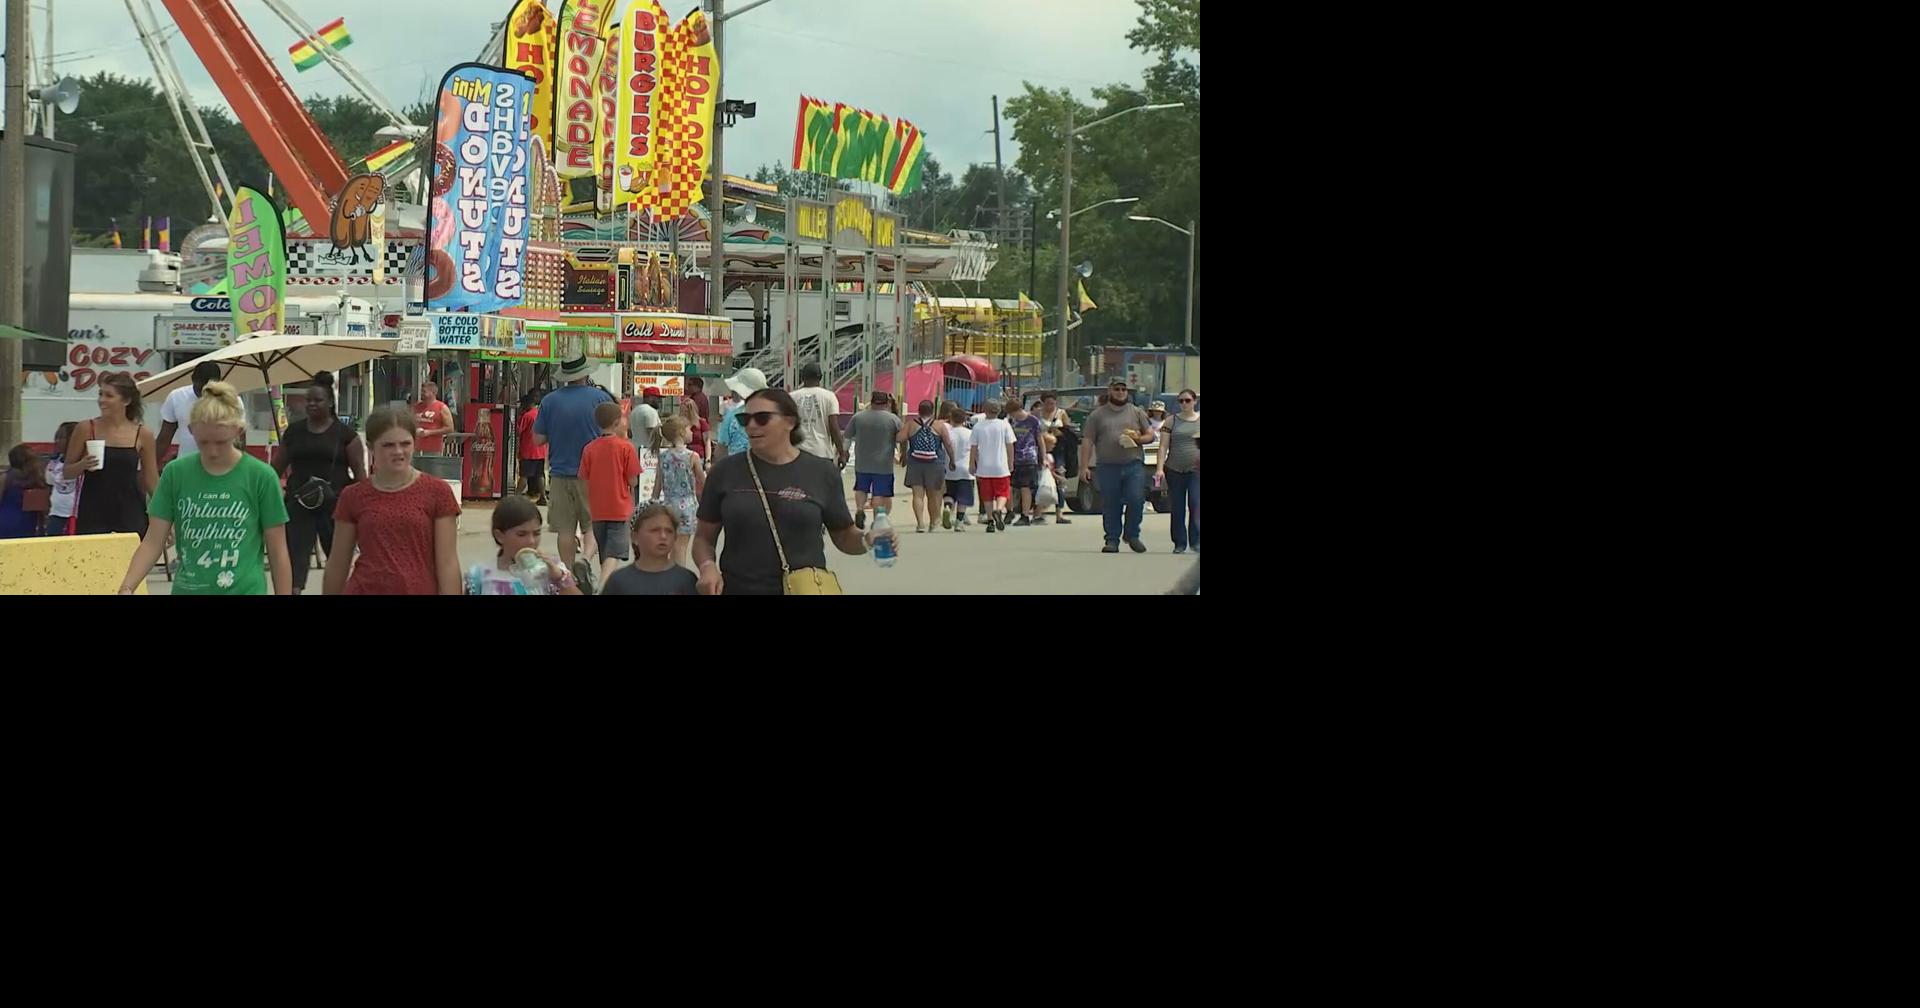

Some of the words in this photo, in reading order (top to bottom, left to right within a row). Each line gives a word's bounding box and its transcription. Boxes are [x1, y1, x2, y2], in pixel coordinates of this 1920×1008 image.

[629, 10, 657, 157] BURGERS
[684, 55, 711, 115] HOT
[576, 274, 607, 285] Italian
[576, 285, 606, 296] Sausage
[172, 323, 231, 332] SHAKE-UPS
[438, 316, 454, 325] ICE
[455, 316, 478, 326] COLD
[624, 321, 654, 338] Cold
[438, 326, 479, 335] BOTTLED
[439, 335, 471, 345] WATER
[69, 344, 153, 367] COZY
[178, 497, 249, 527] Virtually
[181, 519, 247, 548] Anything
[197, 549, 240, 568] 4-H
